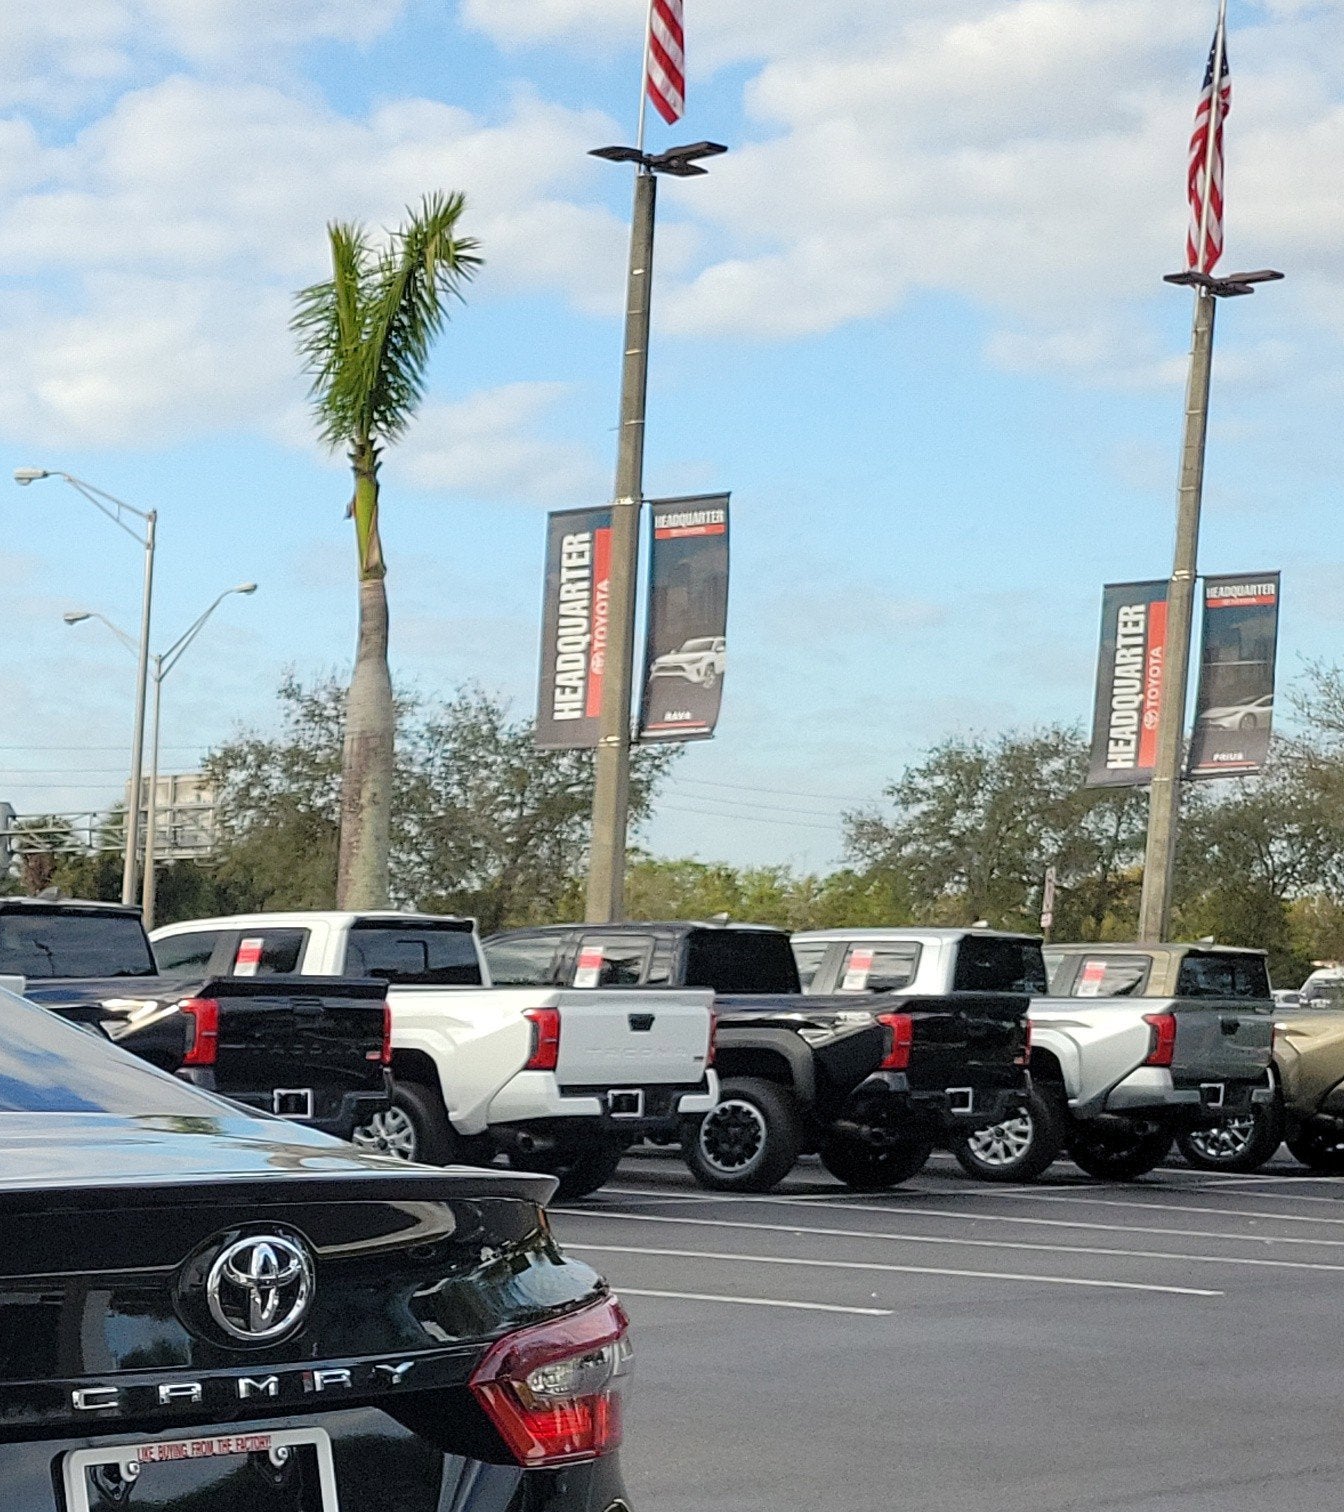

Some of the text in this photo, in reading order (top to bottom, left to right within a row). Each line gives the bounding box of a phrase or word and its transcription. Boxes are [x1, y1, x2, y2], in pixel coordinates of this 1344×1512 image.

[655, 510, 724, 528] HEADQUARTER
[592, 580, 610, 650] TOYOTA
[1206, 584, 1275, 598] HEADQUARTER
[553, 531, 591, 720] HEADQUARTER
[1107, 604, 1146, 769] HEADQUARTER
[1147, 646, 1162, 709] TOYOTA
[72, 1361, 414, 1410] CAMRY
[192, 1441, 214, 1456] FROM
[217, 1438, 232, 1453] THE
